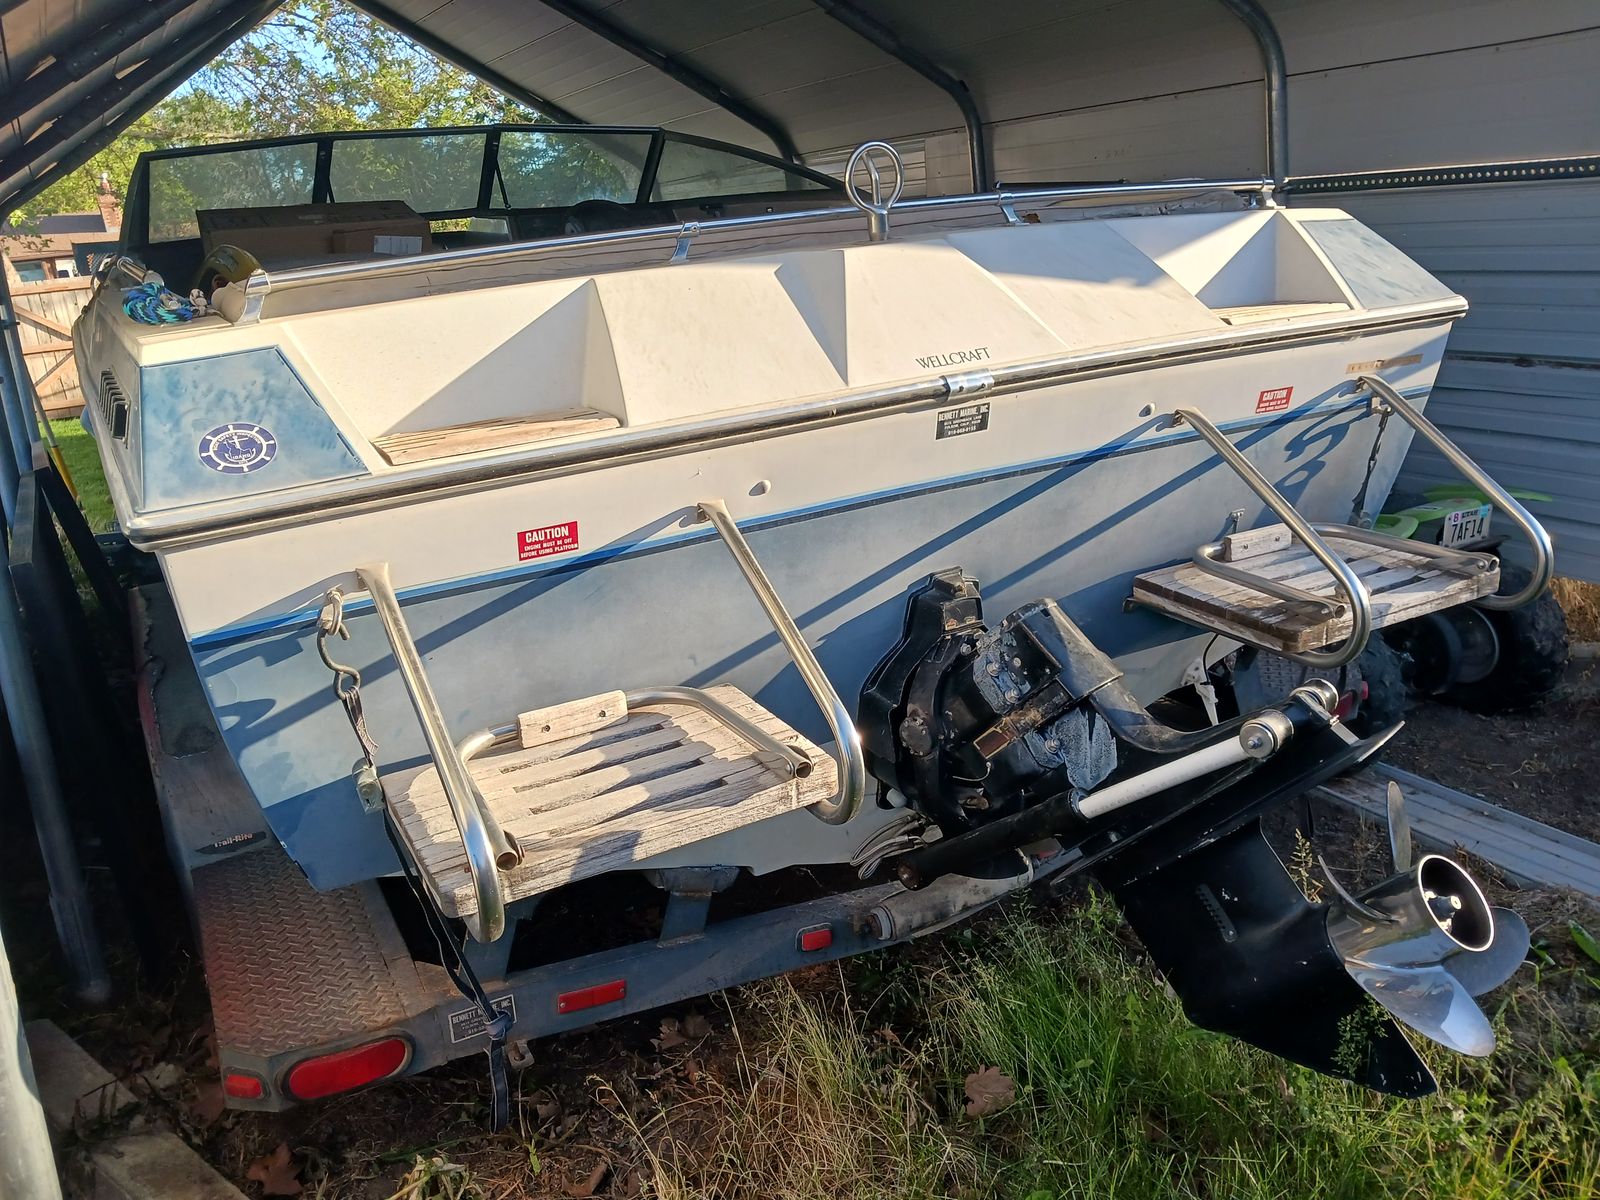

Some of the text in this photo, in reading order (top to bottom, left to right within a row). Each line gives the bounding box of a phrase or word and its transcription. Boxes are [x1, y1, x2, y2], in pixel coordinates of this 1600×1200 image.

[915, 347, 990, 368] WELLCRAFT
[1262, 389, 1288, 401] CAUTION
[939, 410, 959, 421] BENNETT
[1453, 513, 1459, 522] 8
[525, 526, 569, 543] CAUTION
[1452, 518, 1484, 543] 7AF14
[521, 550, 537, 558] BEFORE
[555, 543, 578, 551] PLATFORM
[452, 1010, 476, 1023] BENNETT
